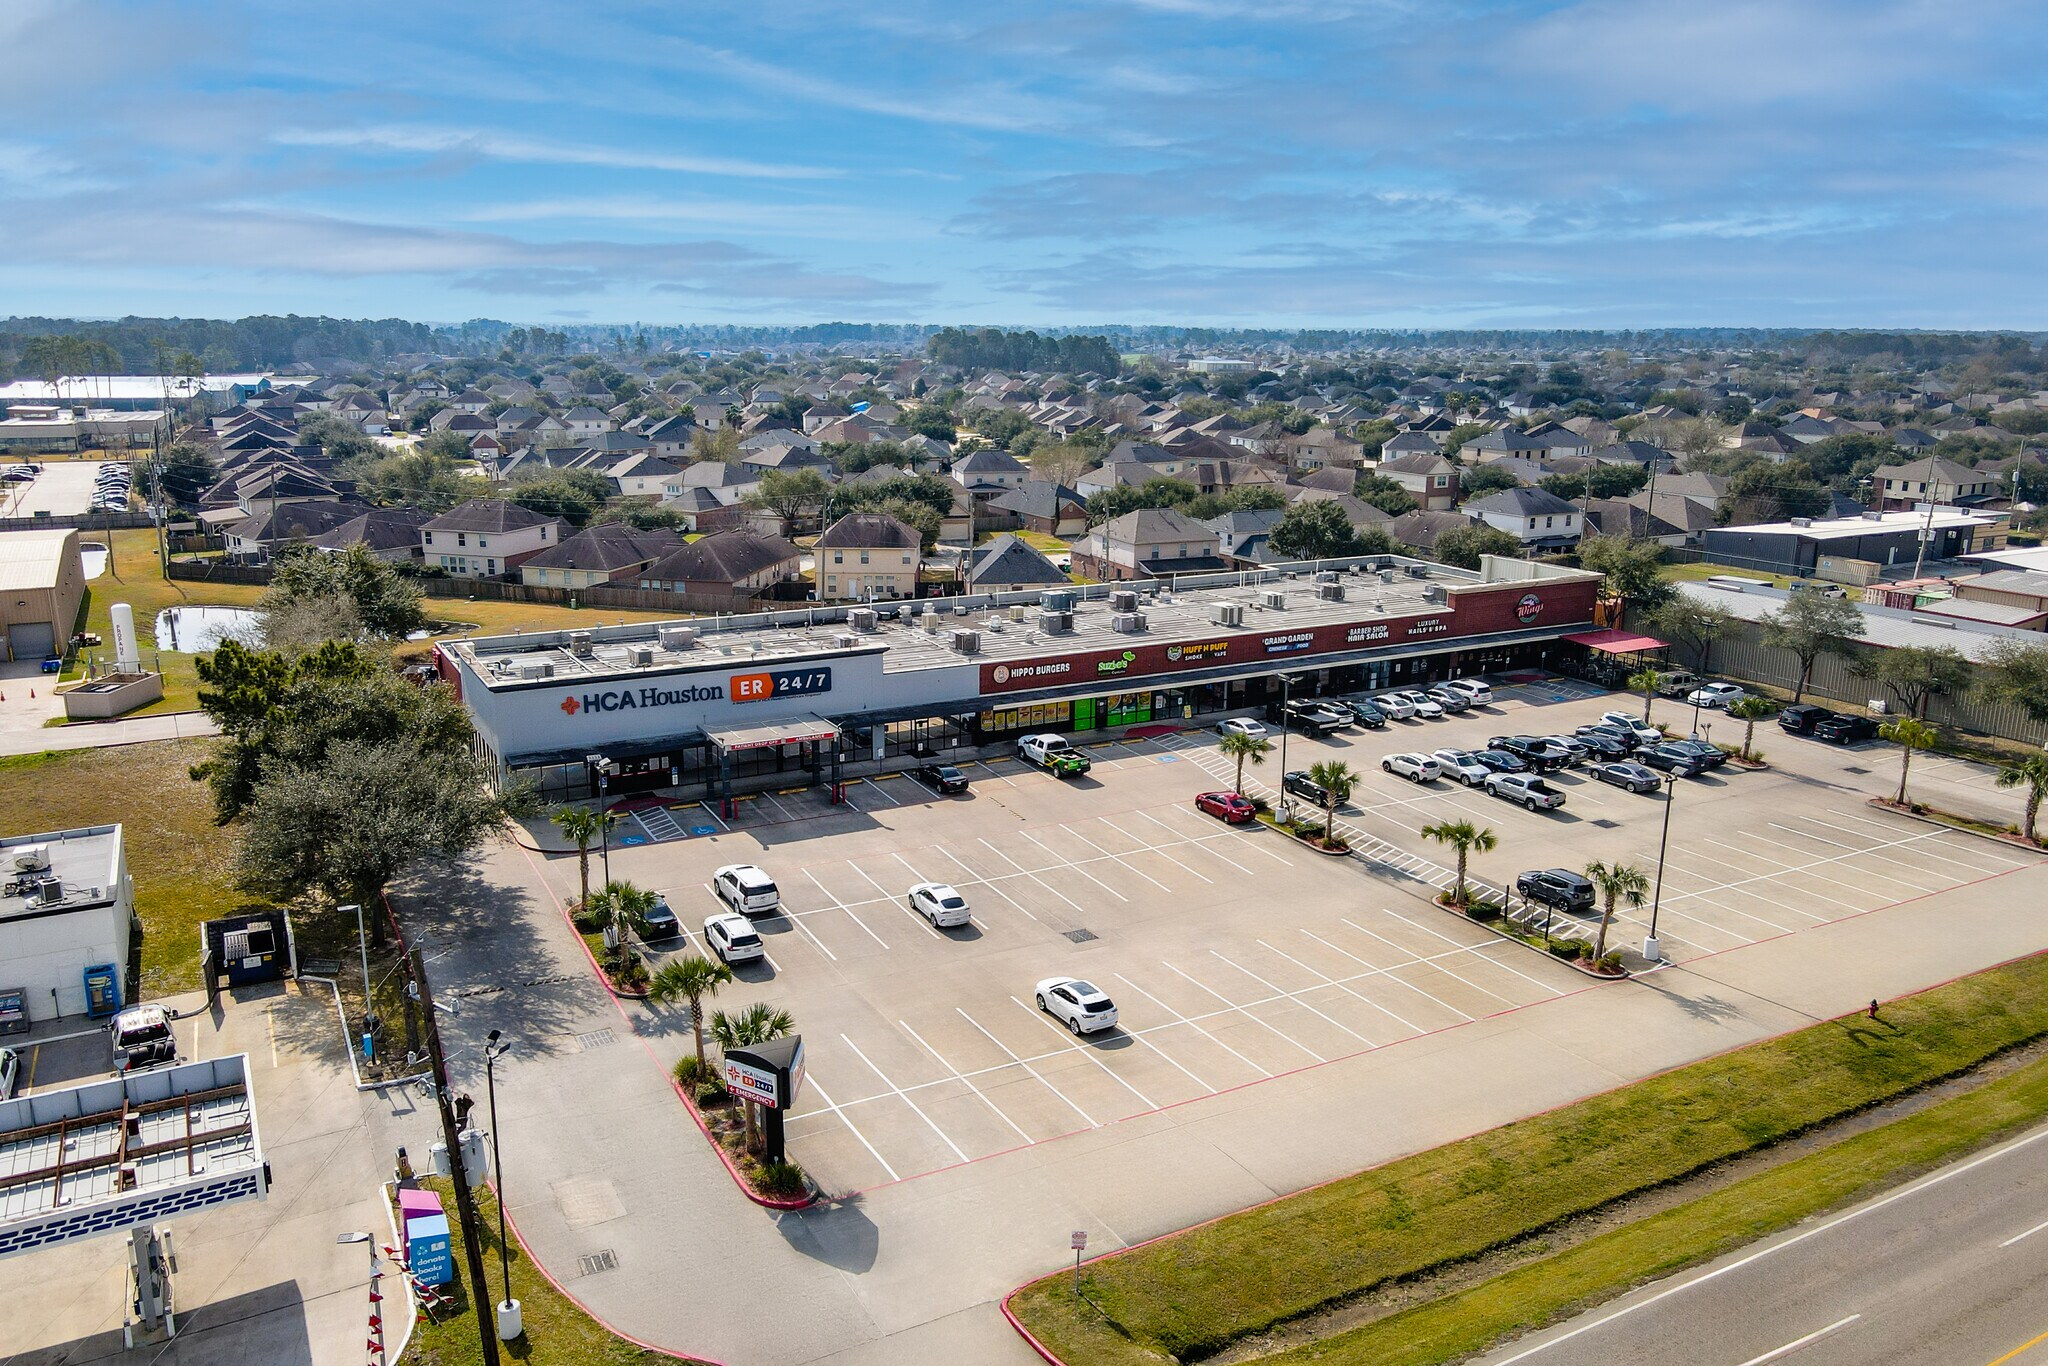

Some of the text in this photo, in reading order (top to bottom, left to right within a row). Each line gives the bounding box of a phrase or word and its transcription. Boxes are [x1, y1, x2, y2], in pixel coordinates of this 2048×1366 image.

[1517, 603, 1544, 617] Wings
[1349, 625, 1388, 636] BARBER SHOP
[1408, 627, 1427, 635] NAILS
[116, 624, 124, 656] PROPANE
[1264, 633, 1314, 645] GRAND GARDEN
[1347, 631, 1389, 643] HAIR SALON
[1182, 642, 1228, 654] HUFF N PUFF
[1184, 653, 1203, 661] SMOKE
[1011, 663, 1070, 678] HIPPO BURGERS
[740, 673, 826, 696] ER 24/7
[583, 690, 637, 714] HCA
[639, 685, 724, 708] Houston
[756, 1081, 772, 1092] 24/7
[735, 1088, 773, 1106] EMERGENCY
[417, 1255, 446, 1266] donate
[418, 1264, 443, 1275] books
[418, 1272, 440, 1283] here!
